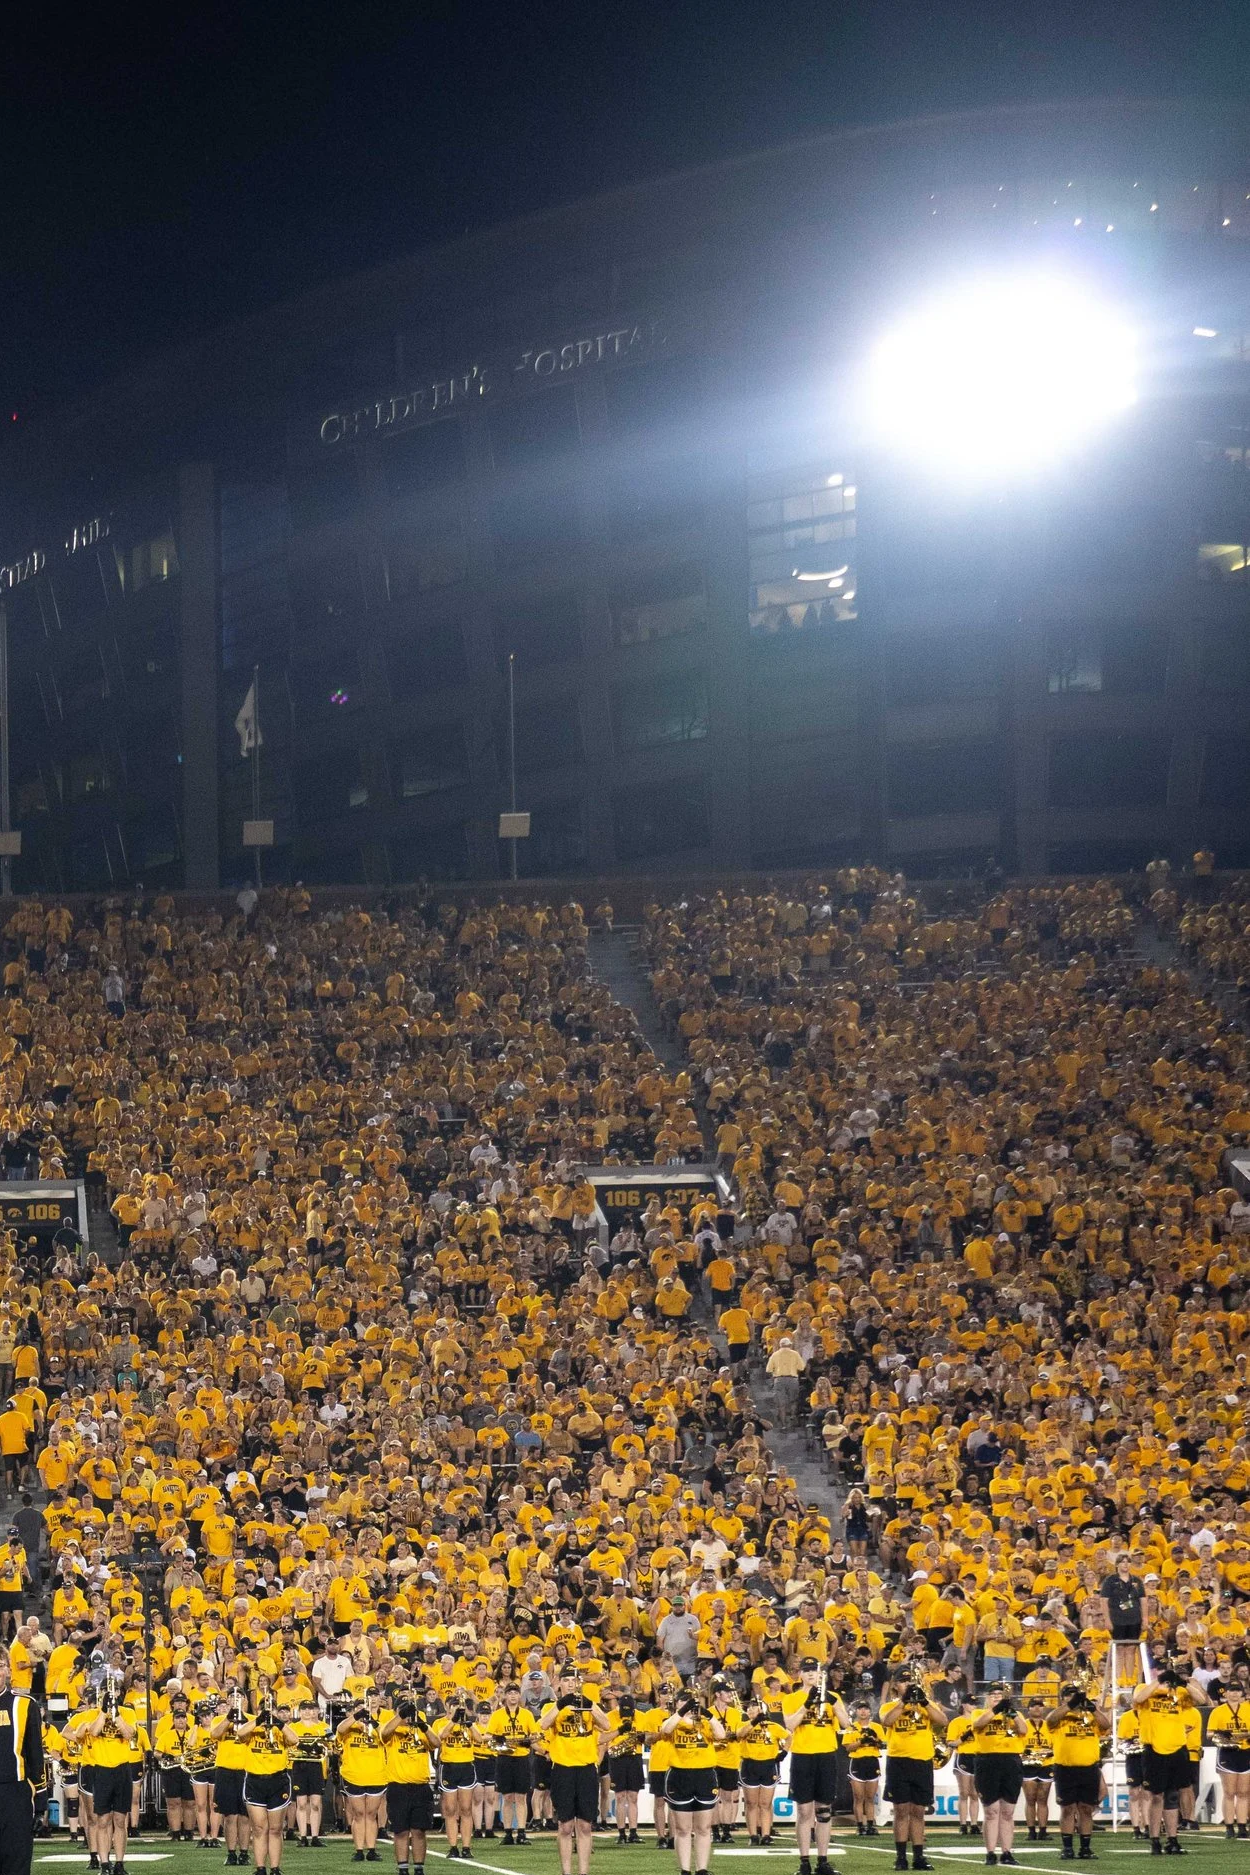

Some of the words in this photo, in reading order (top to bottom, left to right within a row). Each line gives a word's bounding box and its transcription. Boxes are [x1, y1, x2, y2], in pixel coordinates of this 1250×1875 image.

[605, 1190, 640, 1206] 106
[26, 1204, 61, 1220] 106
[305, 1364, 317, 1375] 22
[453, 1632, 470, 1640] IOWA
[555, 1633, 577, 1642] IOWA
[474, 1686, 488, 1694] IOWA
